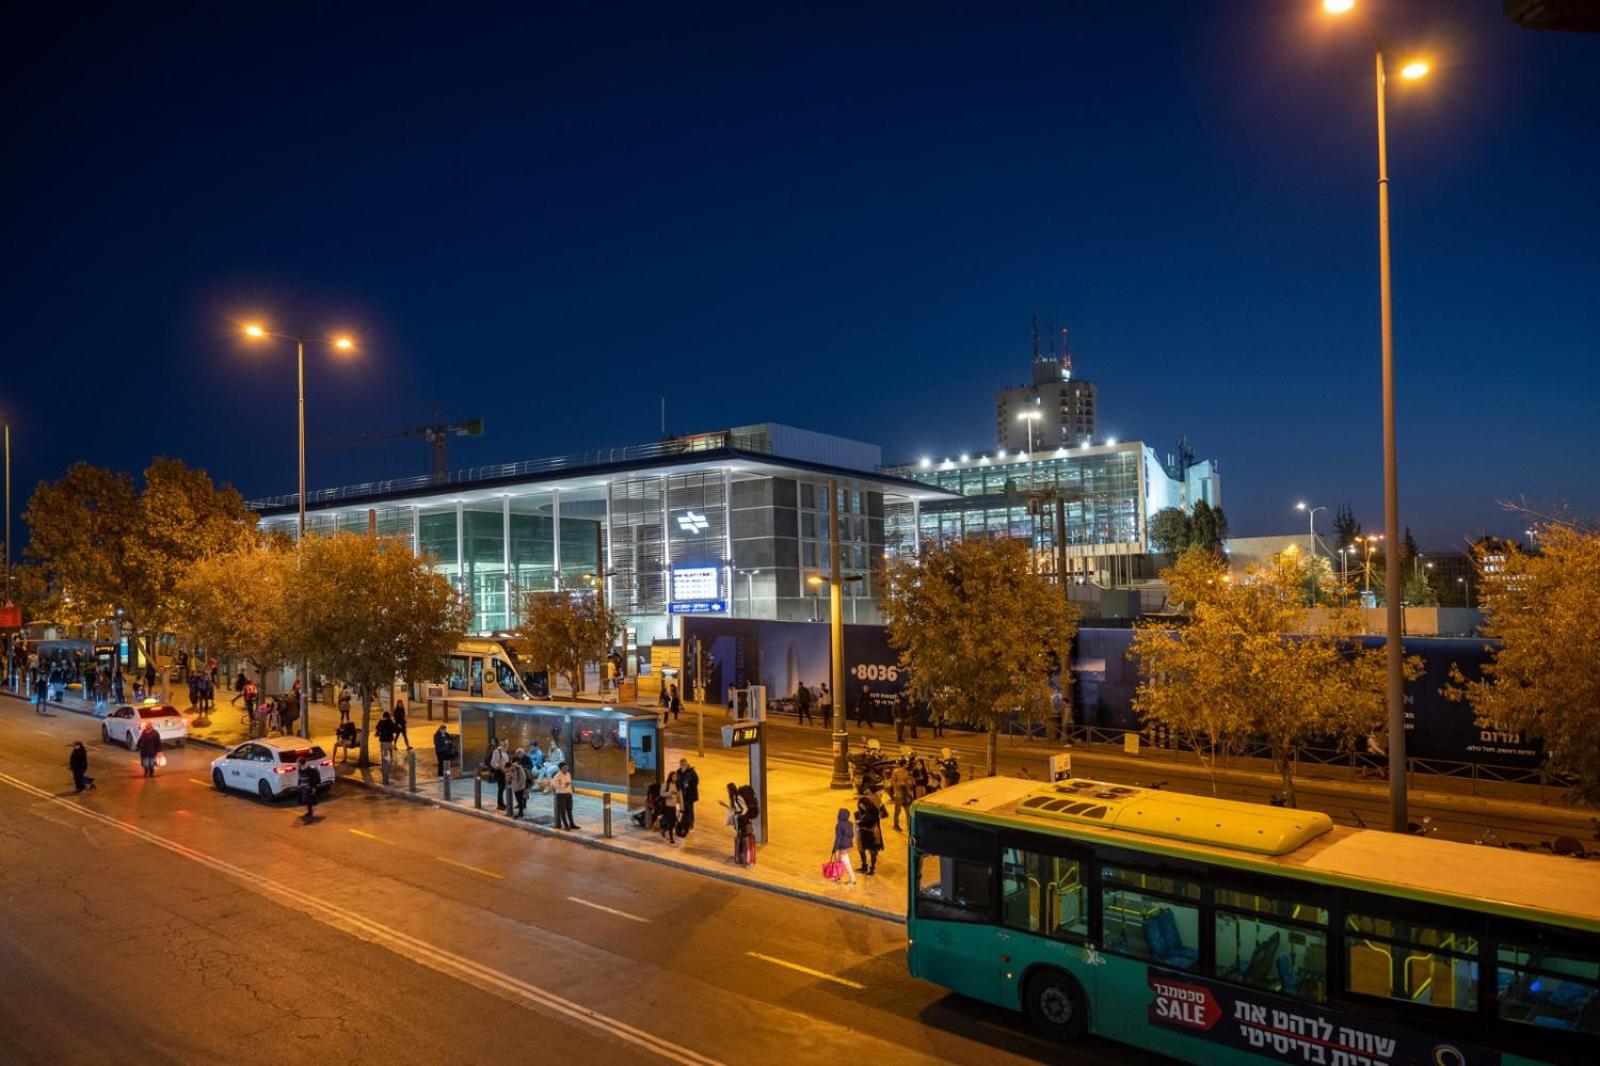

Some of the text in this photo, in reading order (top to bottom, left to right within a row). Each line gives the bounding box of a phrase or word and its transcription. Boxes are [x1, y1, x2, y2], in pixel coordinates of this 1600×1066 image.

[1153, 983, 1205, 1003] ספטמבר
[1156, 997, 1206, 1025] SALE
[1234, 1000, 1397, 1058] שווה לרהט את
[1239, 1024, 1326, 1065] בדיסיטי
